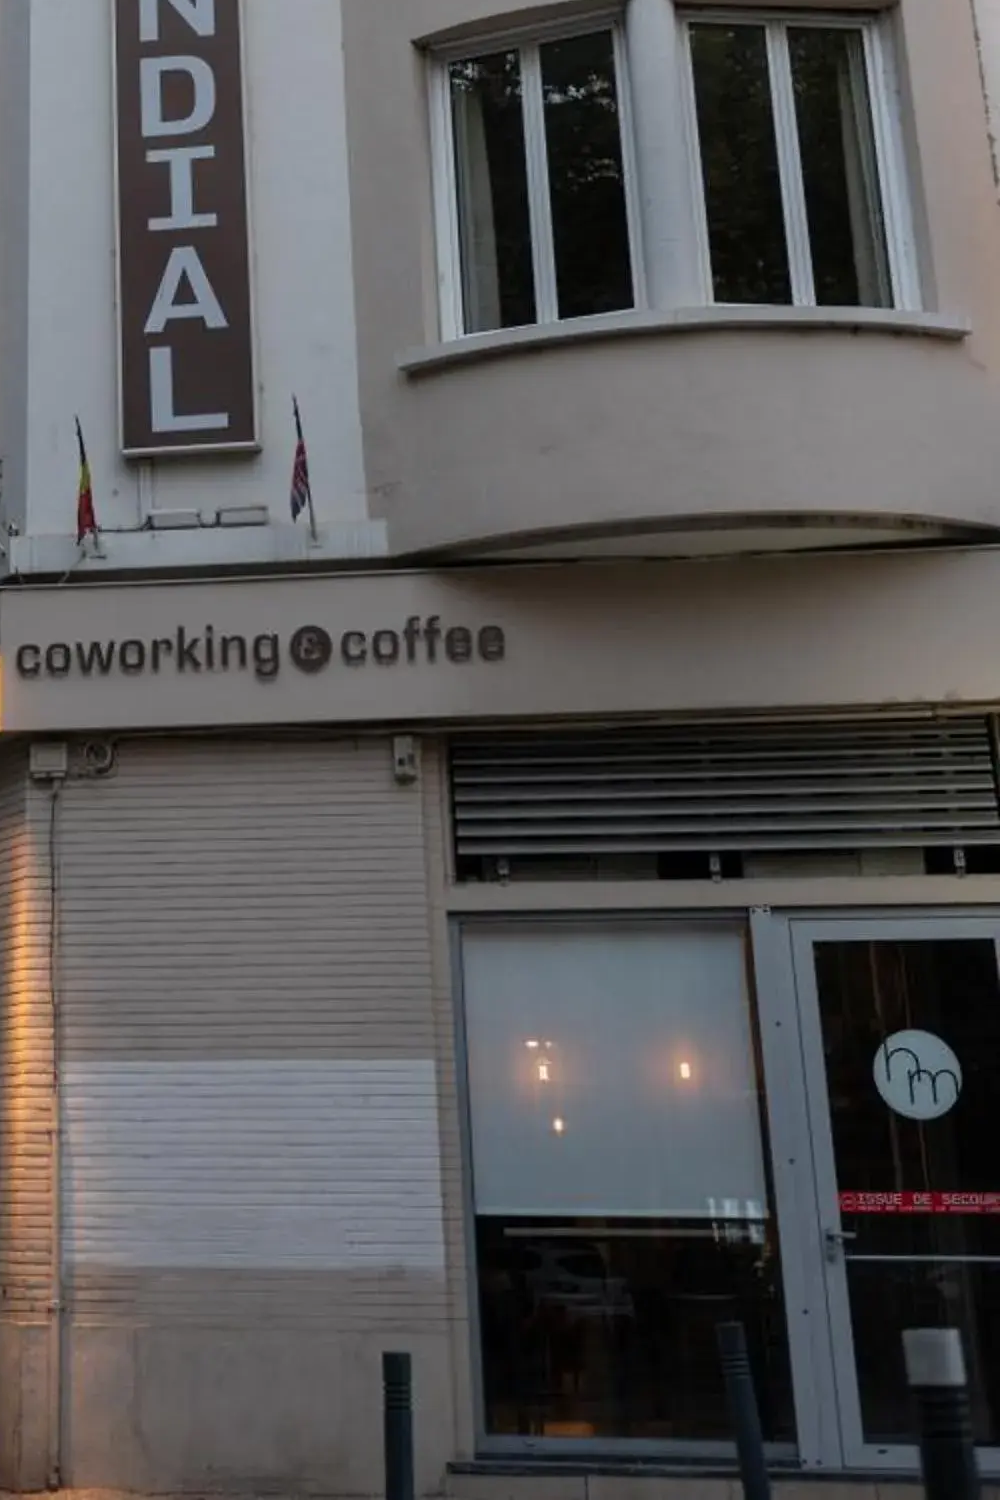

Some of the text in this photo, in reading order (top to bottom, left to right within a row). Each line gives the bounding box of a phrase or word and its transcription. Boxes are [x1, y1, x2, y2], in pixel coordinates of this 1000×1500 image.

[16, 623, 279, 679] coworking
[340, 615, 505, 665] coffee
[857, 1191, 902, 1205] ISSUE
[912, 1191, 933, 1205] DE
